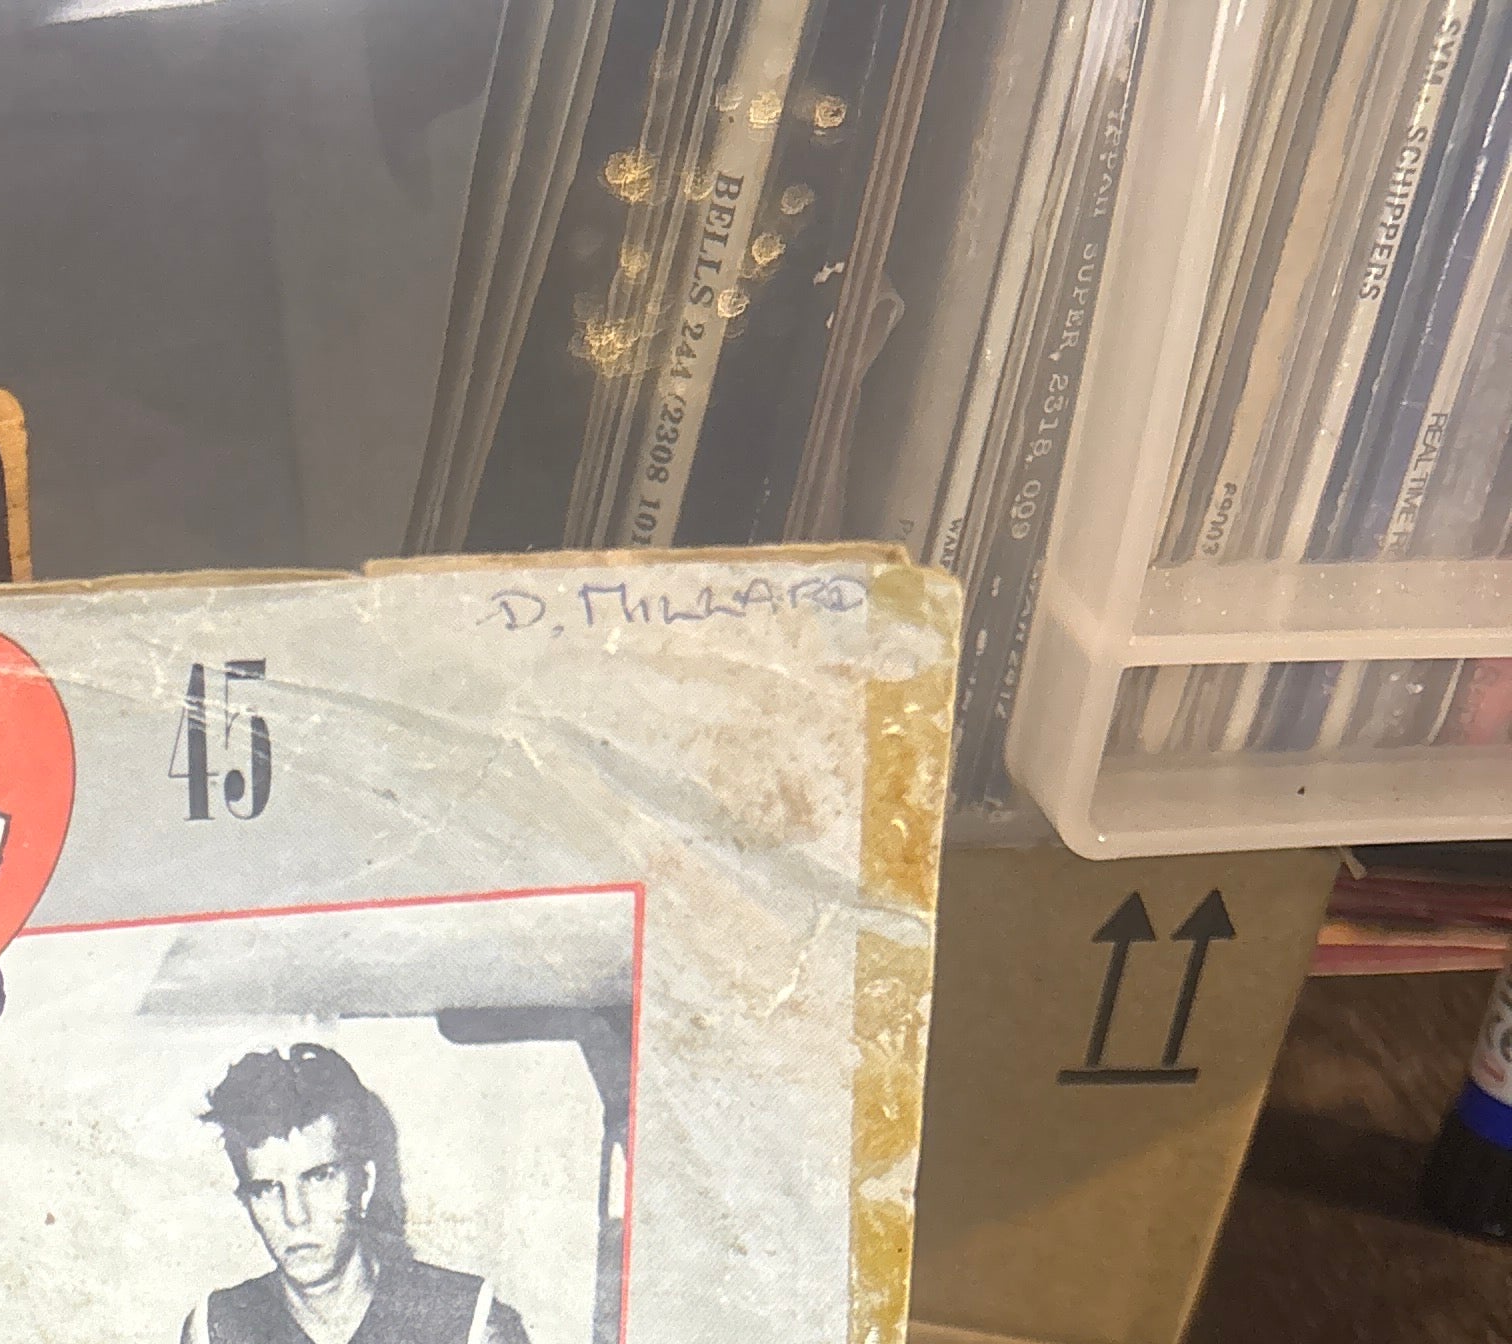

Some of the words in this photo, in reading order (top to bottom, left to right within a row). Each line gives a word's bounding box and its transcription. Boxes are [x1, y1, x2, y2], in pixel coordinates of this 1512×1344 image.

[689, 171, 744, 309] BELLS
[1359, 125, 1428, 301] SCHIPPERS
[1412, 412, 1448, 471] REAL
[169, 657, 272, 821] 45
